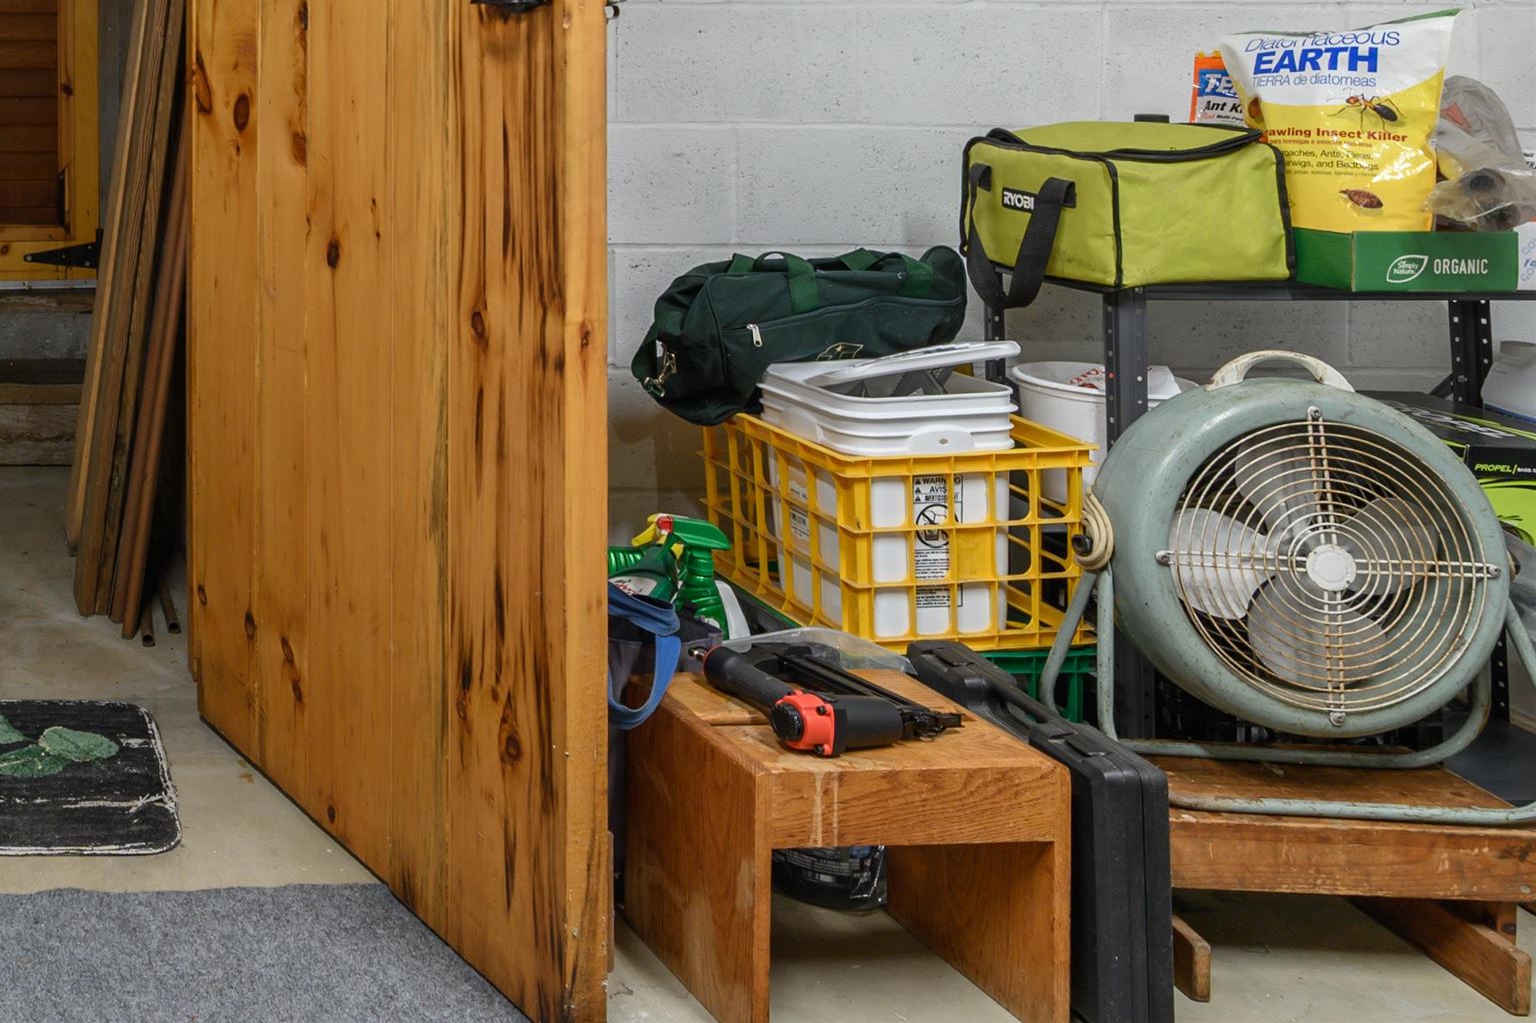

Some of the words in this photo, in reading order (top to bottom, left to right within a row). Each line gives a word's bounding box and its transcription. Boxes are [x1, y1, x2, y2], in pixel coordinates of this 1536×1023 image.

[1253, 47, 1378, 75] EARTH
[1252, 75, 1291, 88] TIERRA
[1293, 73, 1307, 86] de
[1310, 72, 1377, 88] diatomeas
[1203, 100, 1227, 112] Ant
[1264, 127, 1312, 138] rawling
[1316, 127, 1362, 139] Insect
[1367, 129, 1407, 142] Killer
[1320, 149, 1343, 159] Ants,
[1316, 160, 1334, 168] and
[1003, 191, 1035, 210] RYOBI
[1433, 258, 1488, 275] ORGANIC
[922, 476, 961, 485] WARNG
